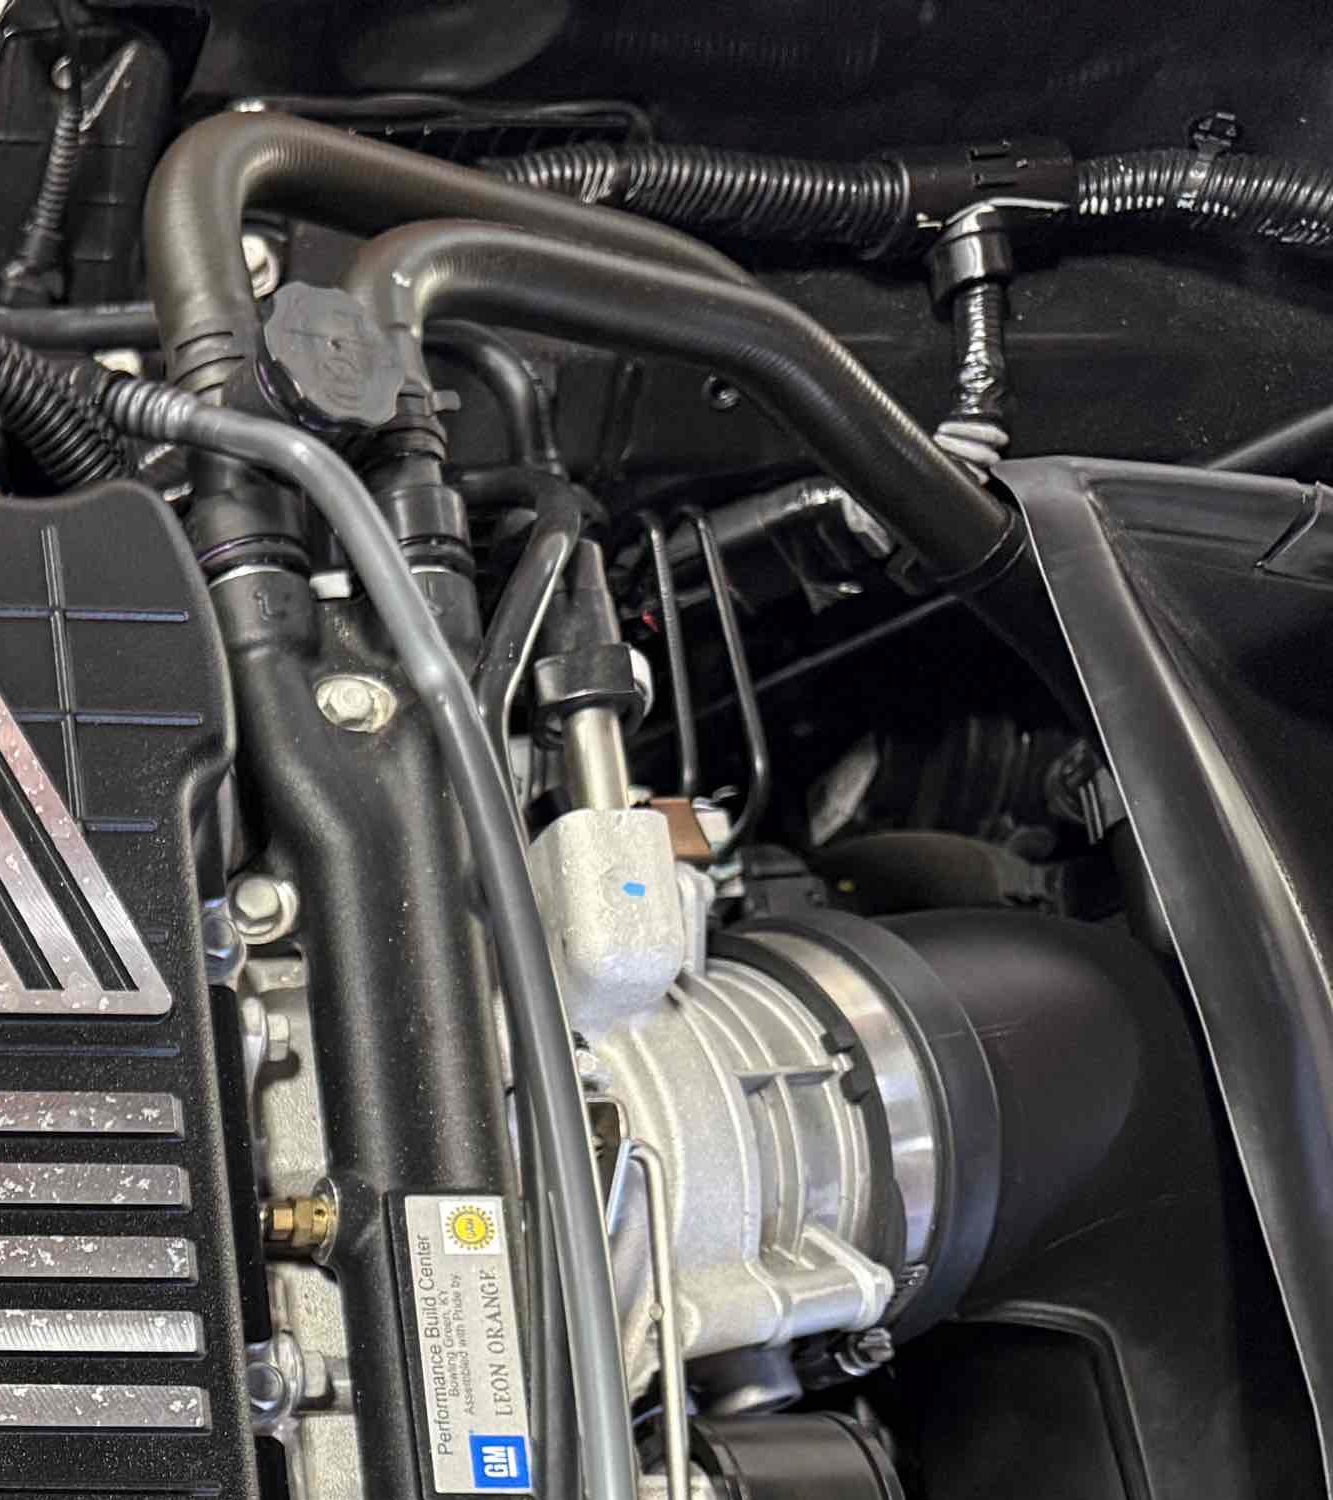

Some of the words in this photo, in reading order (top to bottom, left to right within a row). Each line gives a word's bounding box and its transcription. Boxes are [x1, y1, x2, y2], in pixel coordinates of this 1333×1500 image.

[418, 1234, 434, 1290] Center
[425, 1297, 440, 1339] Build
[441, 1289, 449, 1304] KY
[453, 1287, 464, 1321] Pride
[479, 1267, 505, 1354] ORANGE
[455, 1327, 467, 1349] with
[444, 1351, 460, 1397] Bowling
[456, 1351, 474, 1416] Assembled
[489, 1363, 513, 1417] LEON
[431, 1345, 453, 1456] Performance
[482, 1447, 507, 1478] GM
